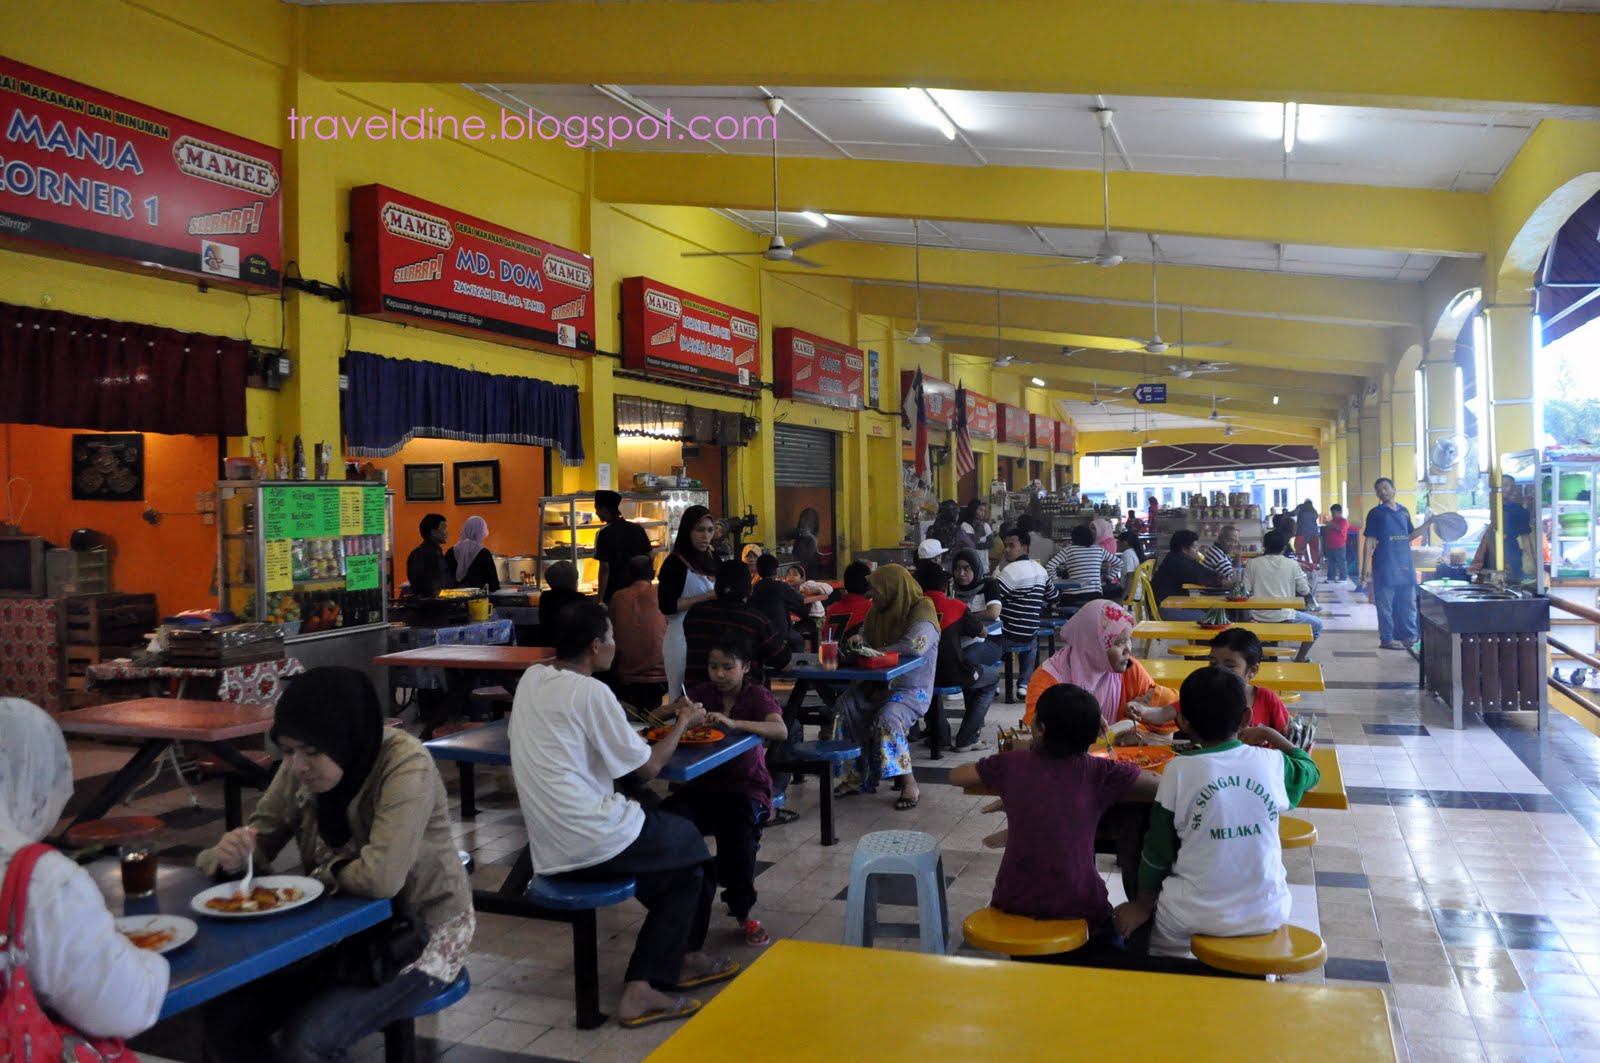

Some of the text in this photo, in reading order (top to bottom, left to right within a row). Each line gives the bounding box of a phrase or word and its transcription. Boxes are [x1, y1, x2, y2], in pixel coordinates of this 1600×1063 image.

[19, 81, 85, 114] MAKANAN
[86, 102, 113, 122] DAN
[114, 111, 169, 139] MINUMAN
[6, 108, 144, 176] MANJA
[185, 146, 270, 187] MAMEE
[0, 155, 159, 226] ORNER 1
[390, 211, 448, 242] MAMEE
[455, 221, 475, 237] GERAI
[475, 228, 504, 246] MAKANAN
[455, 246, 543, 292] MD. DOM
[548, 261, 589, 285] MAMEE
[454, 280, 491, 301] ZAWIYAH
[522, 298, 546, 314] TAHIR
[648, 295, 679, 314] MAMEE
[732, 321, 757, 338] MAMEE
[1191, 775, 1279, 831] SK SUNGAI UDANG
[1210, 823, 1262, 840] MELAKA
